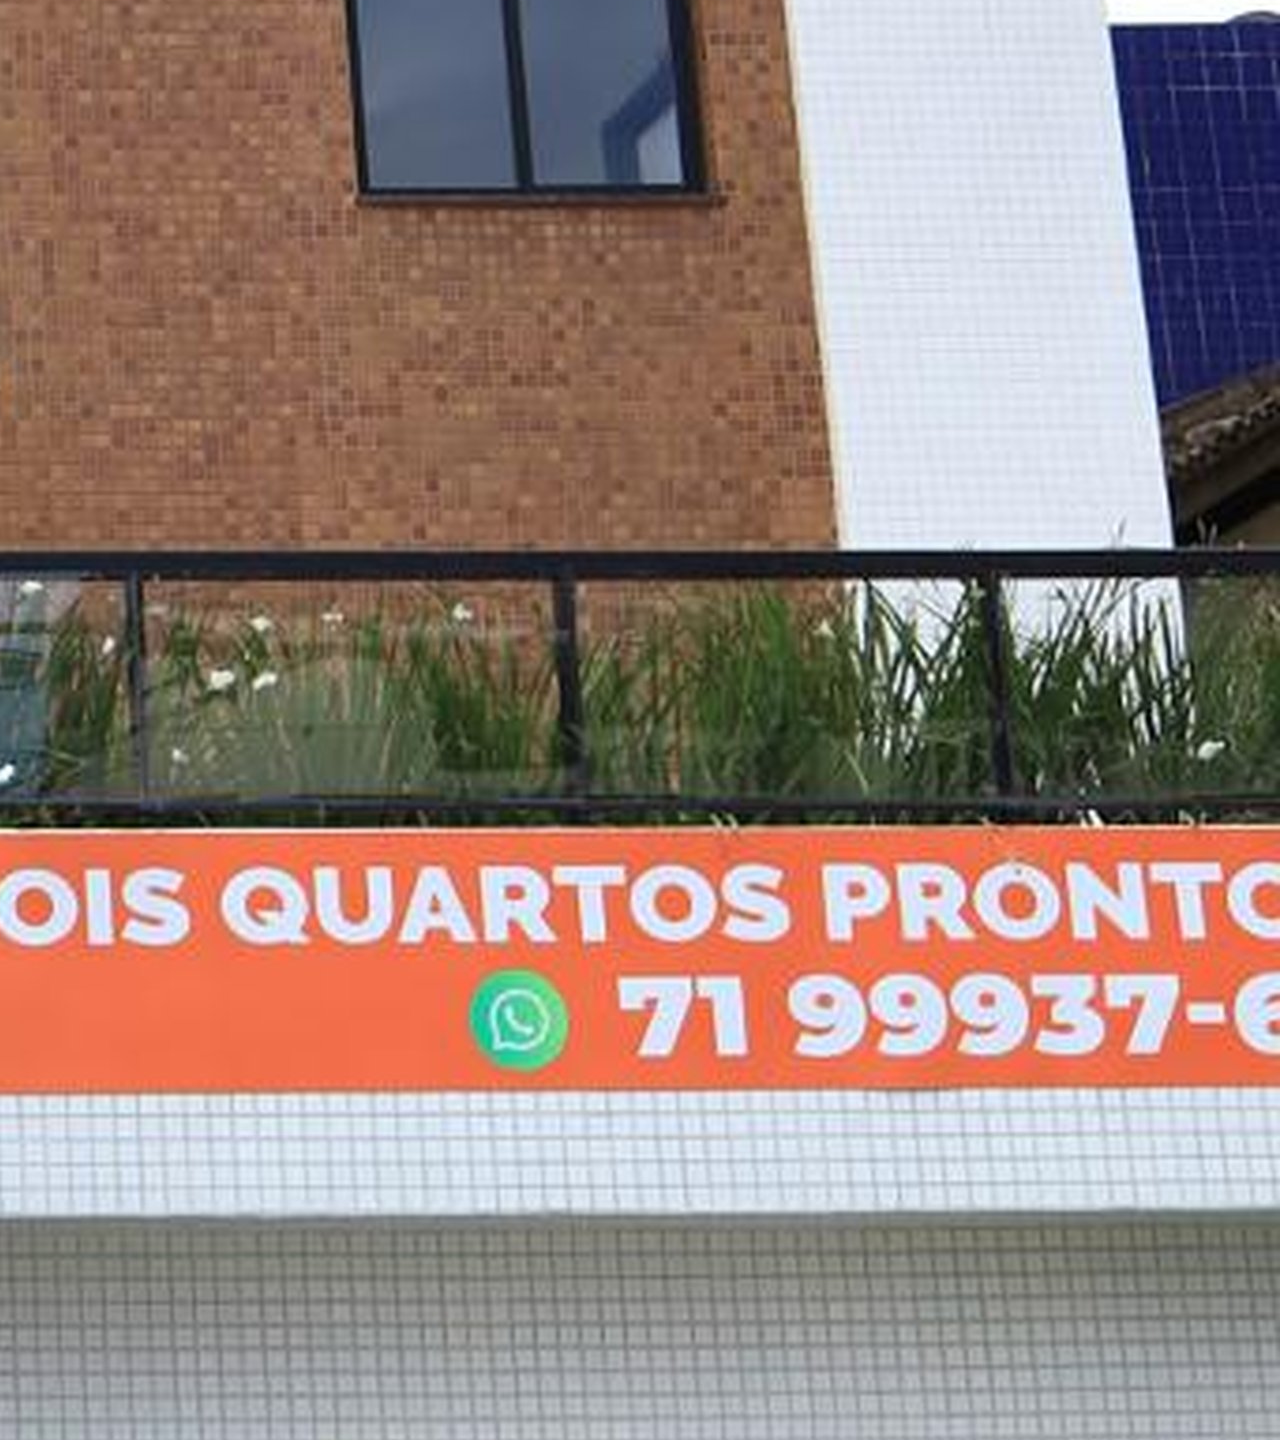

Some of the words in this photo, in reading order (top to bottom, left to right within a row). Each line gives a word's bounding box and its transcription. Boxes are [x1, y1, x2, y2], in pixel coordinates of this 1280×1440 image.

[220, 862, 792, 946] QUARTOS
[821, 860, 1280, 943] PRONTO
[617, 976, 749, 1057] 71
